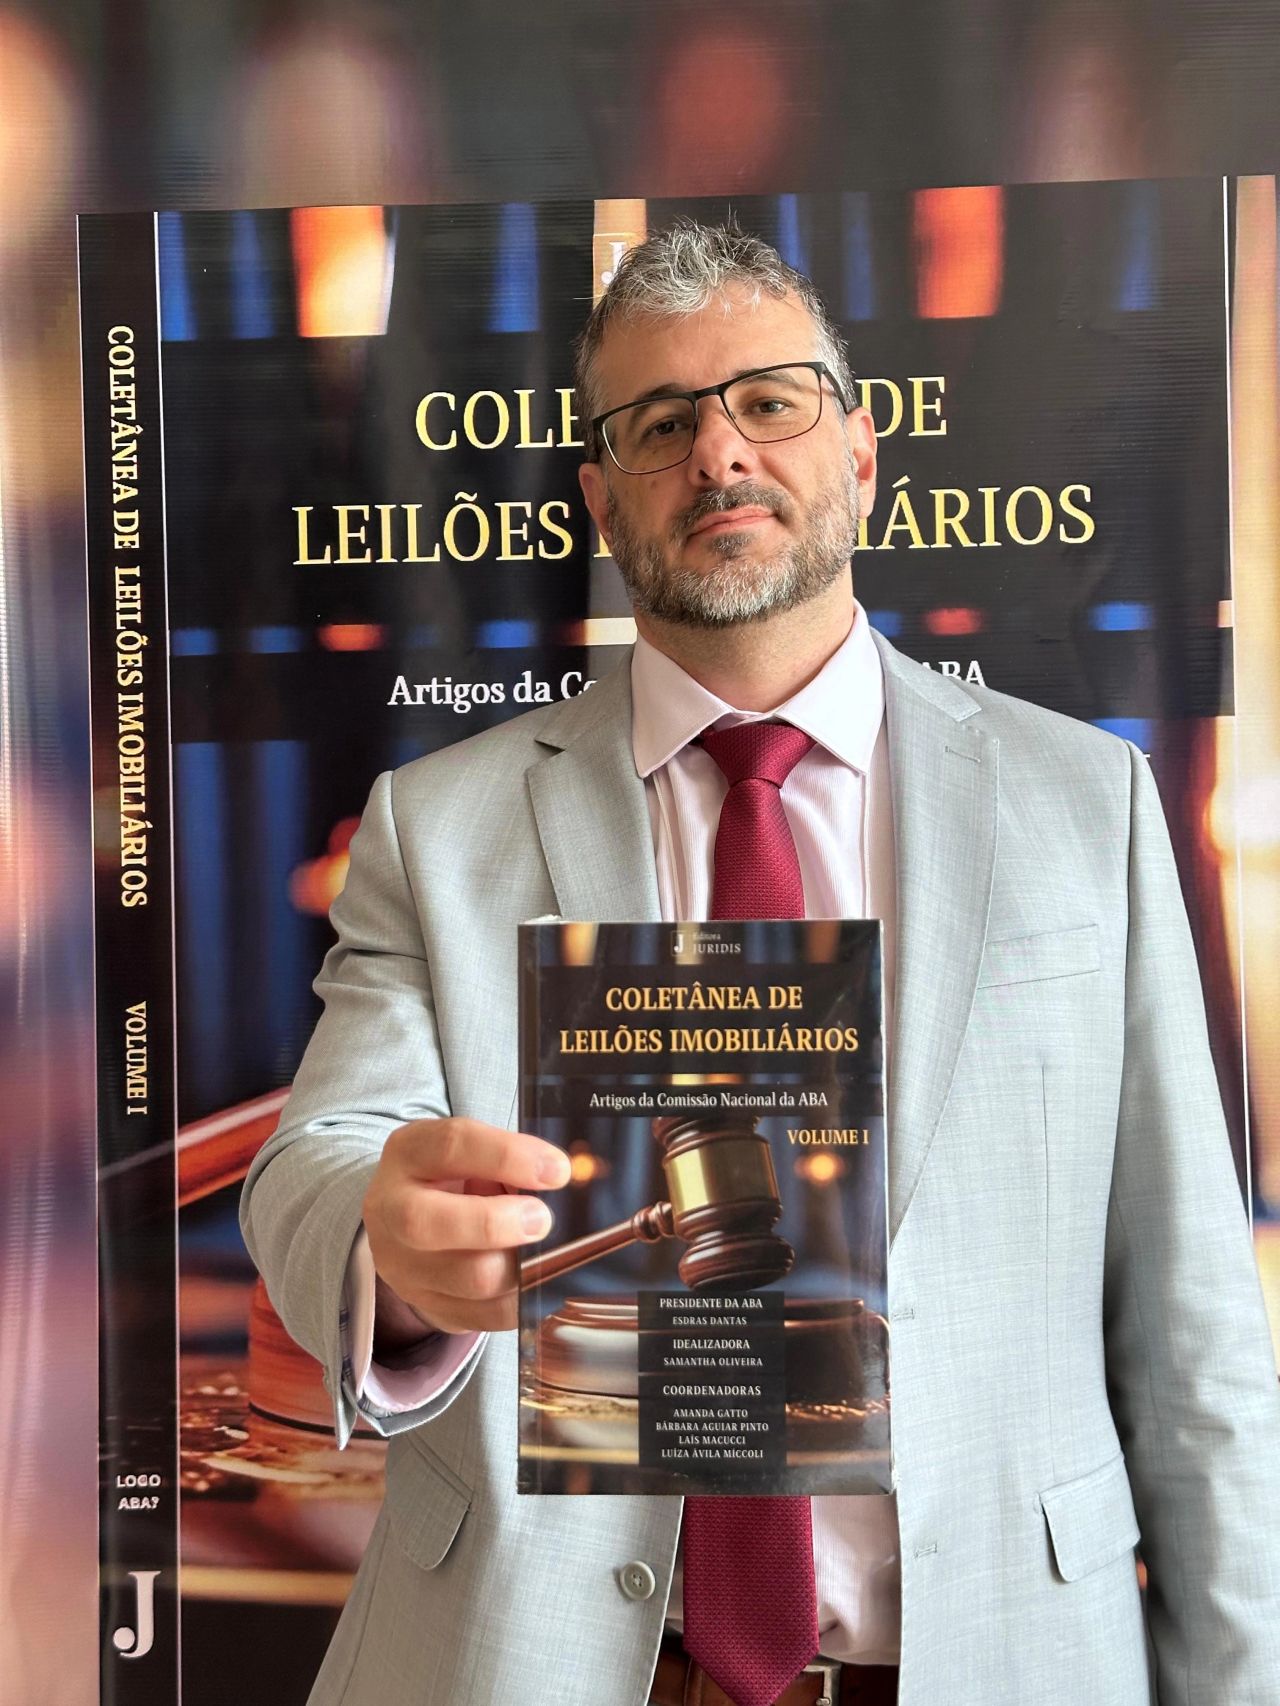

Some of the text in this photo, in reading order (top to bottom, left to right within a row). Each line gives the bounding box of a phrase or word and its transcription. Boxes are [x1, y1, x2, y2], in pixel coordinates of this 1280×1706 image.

[855, 376, 947, 438] DE
[291, 491, 573, 565] LEILÕES
[108, 325, 153, 908] COLETÂNEA DE LEILÕES IMOBILIÁRIOS
[387, 675, 506, 714] Artigos
[512, 670, 554, 703] da
[692, 943, 742, 954] JURIDIS
[605, 981, 803, 1011] COLETÂNEA DE
[559, 1022, 859, 1054] LEILÕES IMOBILIÁRIOS
[125, 1000, 148, 1115] VOLUME I
[589, 1091, 828, 1109] Artigos da Comissão Nacional da ABA
[787, 1129, 870, 1145] VOLUME I
[660, 1298, 763, 1309] PRESIDENTE DA ABA
[672, 1316, 747, 1325] ESDRAS DANTAS
[673, 1339, 750, 1349] IDEALIZADORA
[663, 1357, 763, 1366] SAMANTHA OLIVEIRA
[663, 1385, 762, 1396] COORDENADORAS
[673, 1408, 748, 1418] AMANDA GATTO
[656, 1421, 769, 1431] BÁRBARA AGUIAR PINTO
[702, 1435, 746, 1445] MACUCCI
[692, 1448, 721, 1458] ÁVILA
[116, 1474, 161, 1488] LOGO
[113, 1570, 162, 1658] J
